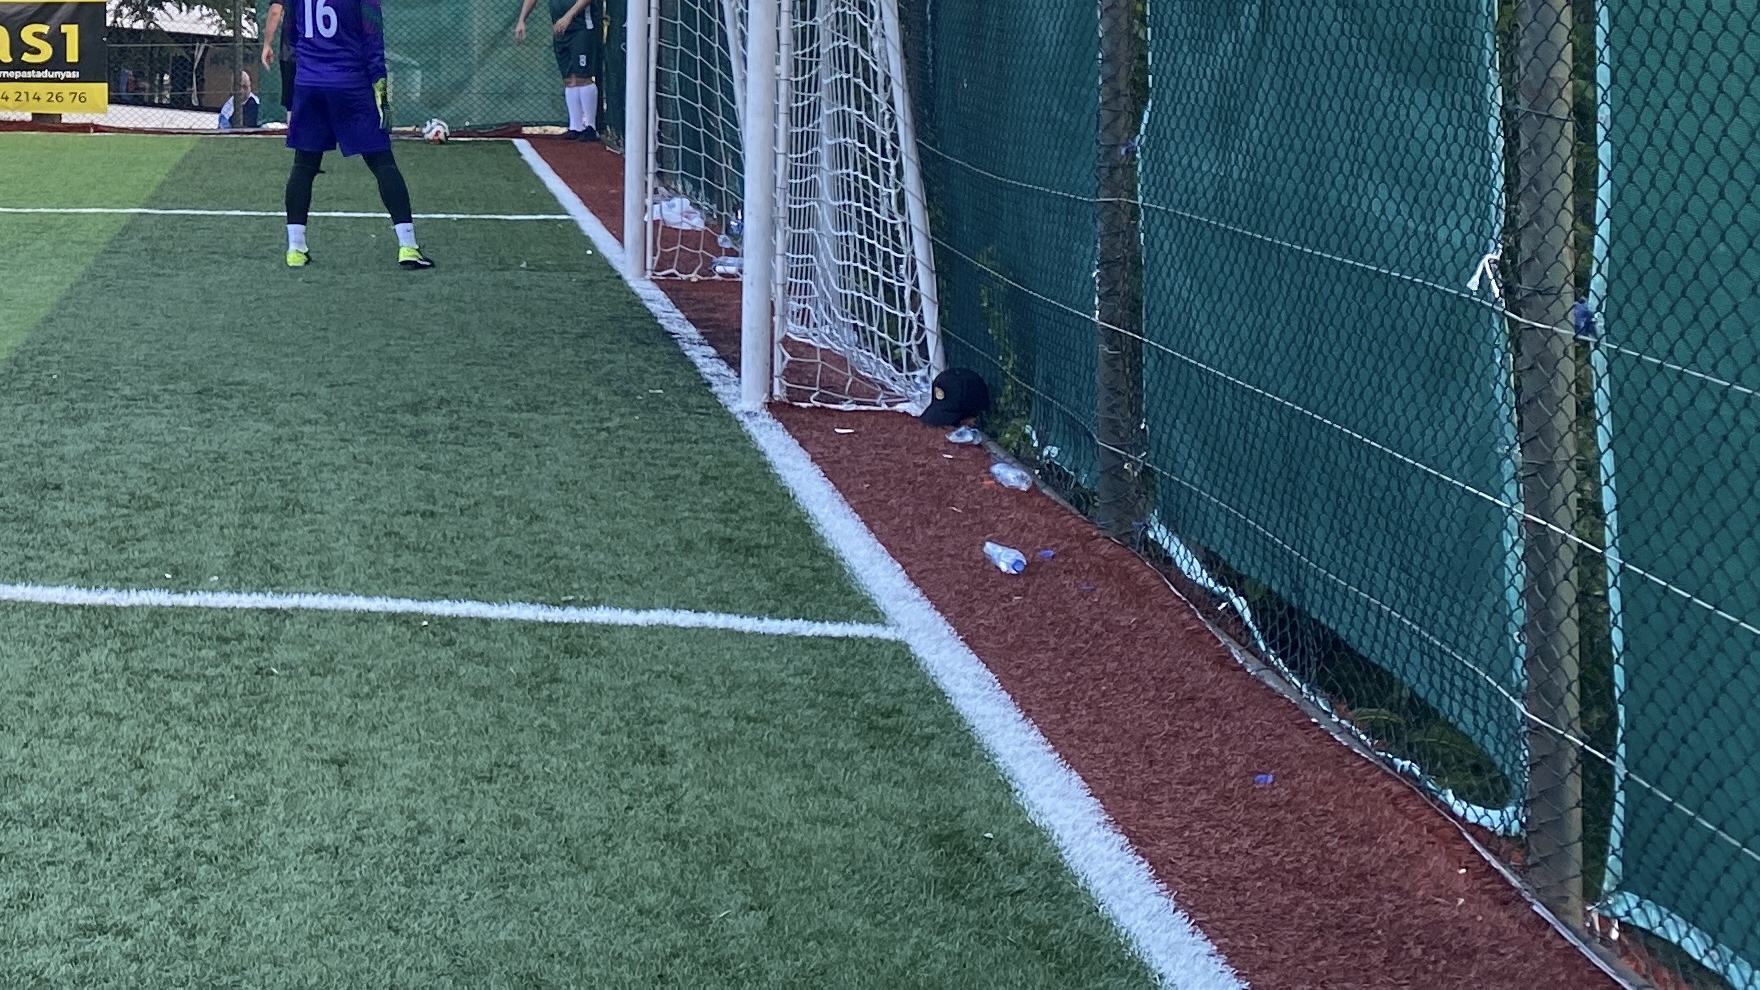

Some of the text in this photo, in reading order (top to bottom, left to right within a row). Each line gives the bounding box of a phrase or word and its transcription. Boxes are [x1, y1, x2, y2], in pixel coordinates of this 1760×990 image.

[14, 91, 41, 103] 214
[46, 91, 64, 103] 26
[69, 92, 87, 103] 76
